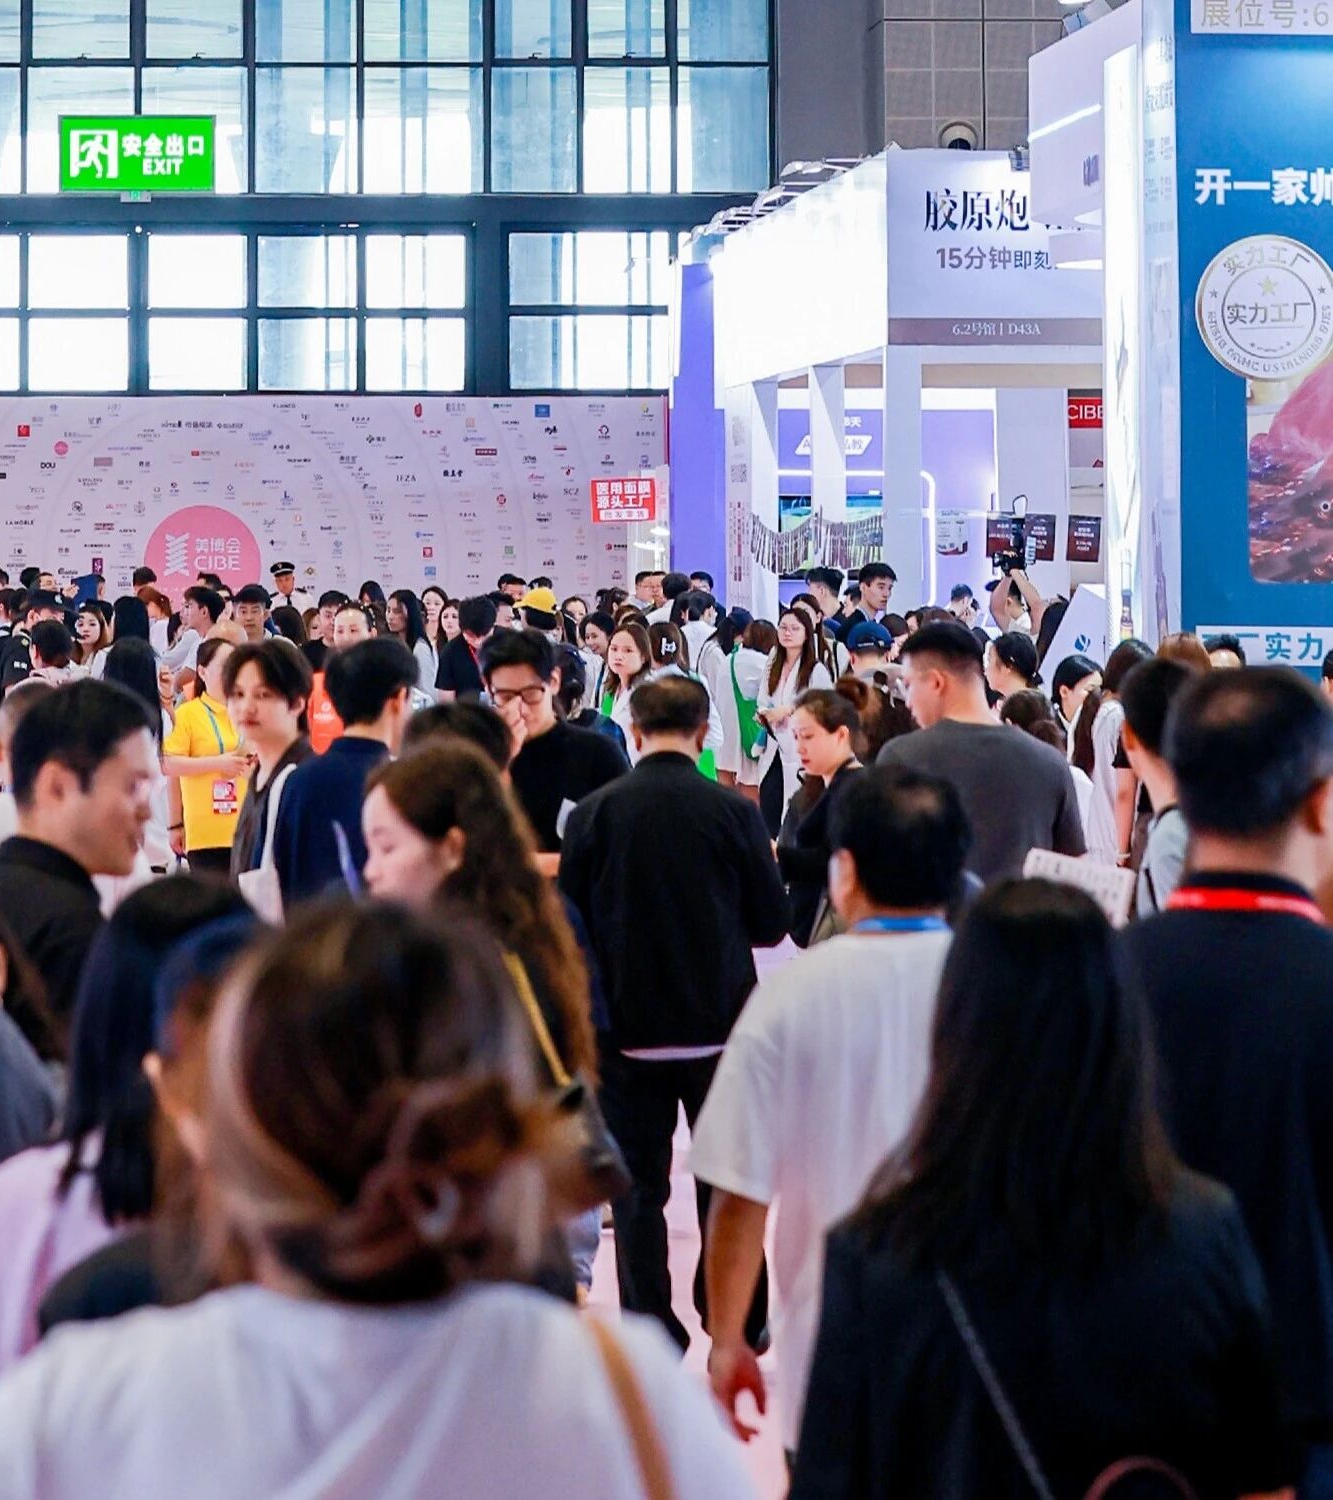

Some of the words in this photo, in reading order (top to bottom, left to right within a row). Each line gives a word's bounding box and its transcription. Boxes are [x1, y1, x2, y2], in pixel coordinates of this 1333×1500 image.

[122, 132, 204, 157] 安全出口
[142, 158, 183, 175] EXIT
[924, 188, 1087, 232] 胶原炮
[937, 246, 1058, 270] 15分钟即刻
[1223, 244, 1310, 276] 实力工厂
[1227, 302, 1311, 325] 实力工厂
[1008, 323, 1041, 335] D43A
[597, 494, 651, 509] 源头工厂
[194, 537, 241, 554] 美博会
[193, 555, 241, 571] CIBE
